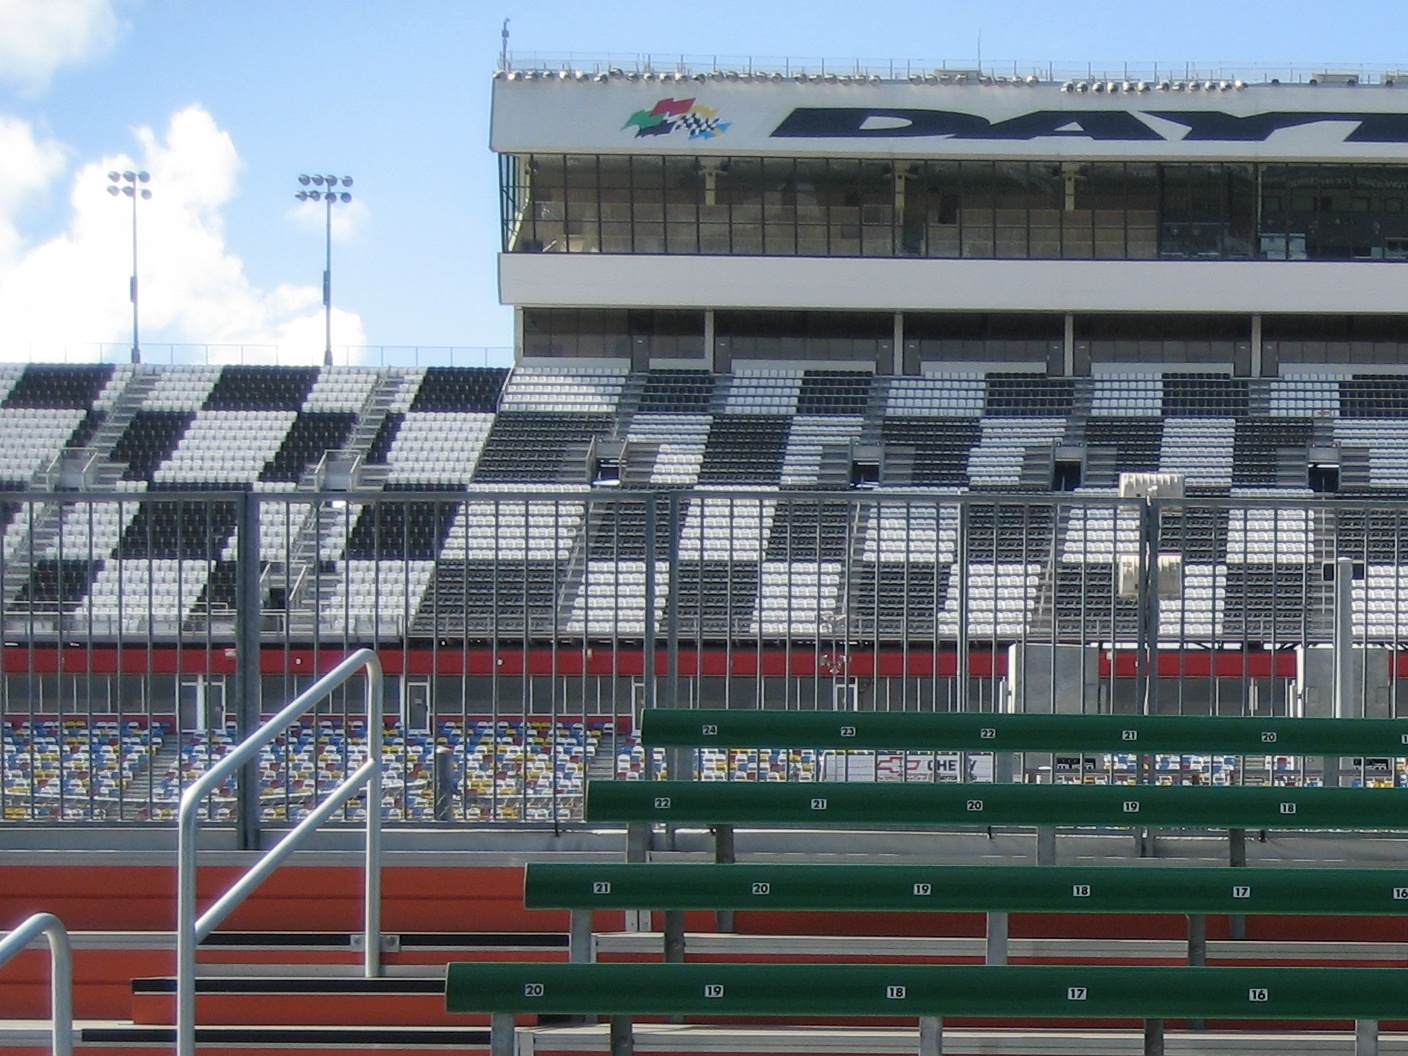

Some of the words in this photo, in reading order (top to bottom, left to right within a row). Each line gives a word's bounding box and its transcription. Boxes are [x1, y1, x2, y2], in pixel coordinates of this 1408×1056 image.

[981, 729, 995, 738] 22
[1124, 731, 1135, 740] 21
[1262, 733, 1276, 742] 20
[927, 759, 977, 772] CHEY
[655, 799, 670, 808] 22
[813, 800, 825, 809] 21
[967, 801, 982, 810] 20
[1126, 802, 1138, 812] 19
[1282, 804, 1295, 813] 18
[595, 884, 608, 893] 21
[753, 884, 769, 893] 20
[916, 885, 930, 894] 19
[1076, 886, 1089, 896] 18
[1236, 887, 1249, 897] 17
[1395, 889, 1408, 898] 16
[526, 985, 543, 995] 20
[707, 986, 722, 995] 19
[889, 988, 904, 997] 18
[1070, 989, 1085, 998] 17
[1251, 990, 1266, 1000] 16
